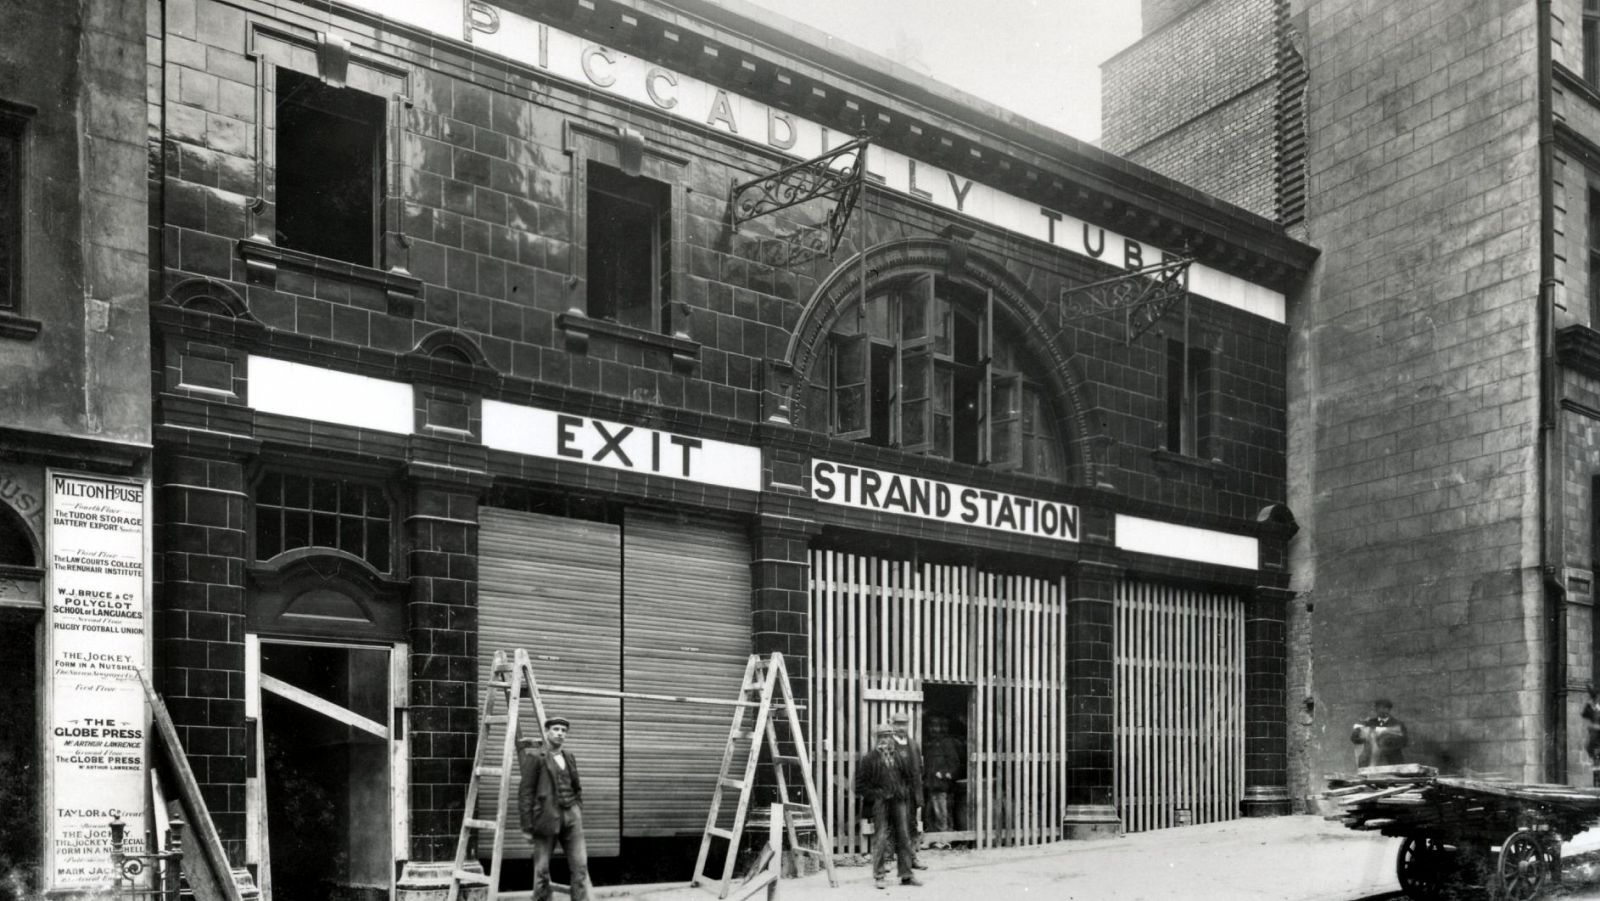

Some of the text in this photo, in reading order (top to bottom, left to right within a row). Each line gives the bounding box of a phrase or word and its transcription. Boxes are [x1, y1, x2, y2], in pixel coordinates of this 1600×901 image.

[557, 414, 702, 477] EXIT
[55, 478, 104, 499] MILTON
[813, 461, 1079, 541] STRAND STATION
[55, 509, 143, 526] The TUDOR STORAGE
[53, 517, 87, 529] BATTERY
[89, 521, 118, 531] EXPORT
[54, 554, 143, 569] The LAW COURTS COLLEGE
[104, 567, 143, 577] INSTITUTE
[78, 589, 112, 599] BRUCE
[64, 597, 132, 610] POLYGLOT
[53, 605, 84, 615] SCHOOL
[54, 623, 143, 635] RUGBY FOOTBALL UNION
[62, 651, 83, 660] THE
[84, 718, 115, 726] THE
[54, 727, 99, 738] GLOBE
[56, 755, 69, 763] The
[70, 756, 104, 764] GLOBE
[57, 808, 100, 817] TAYLOR
[73, 839, 108, 847] JOCKEY
